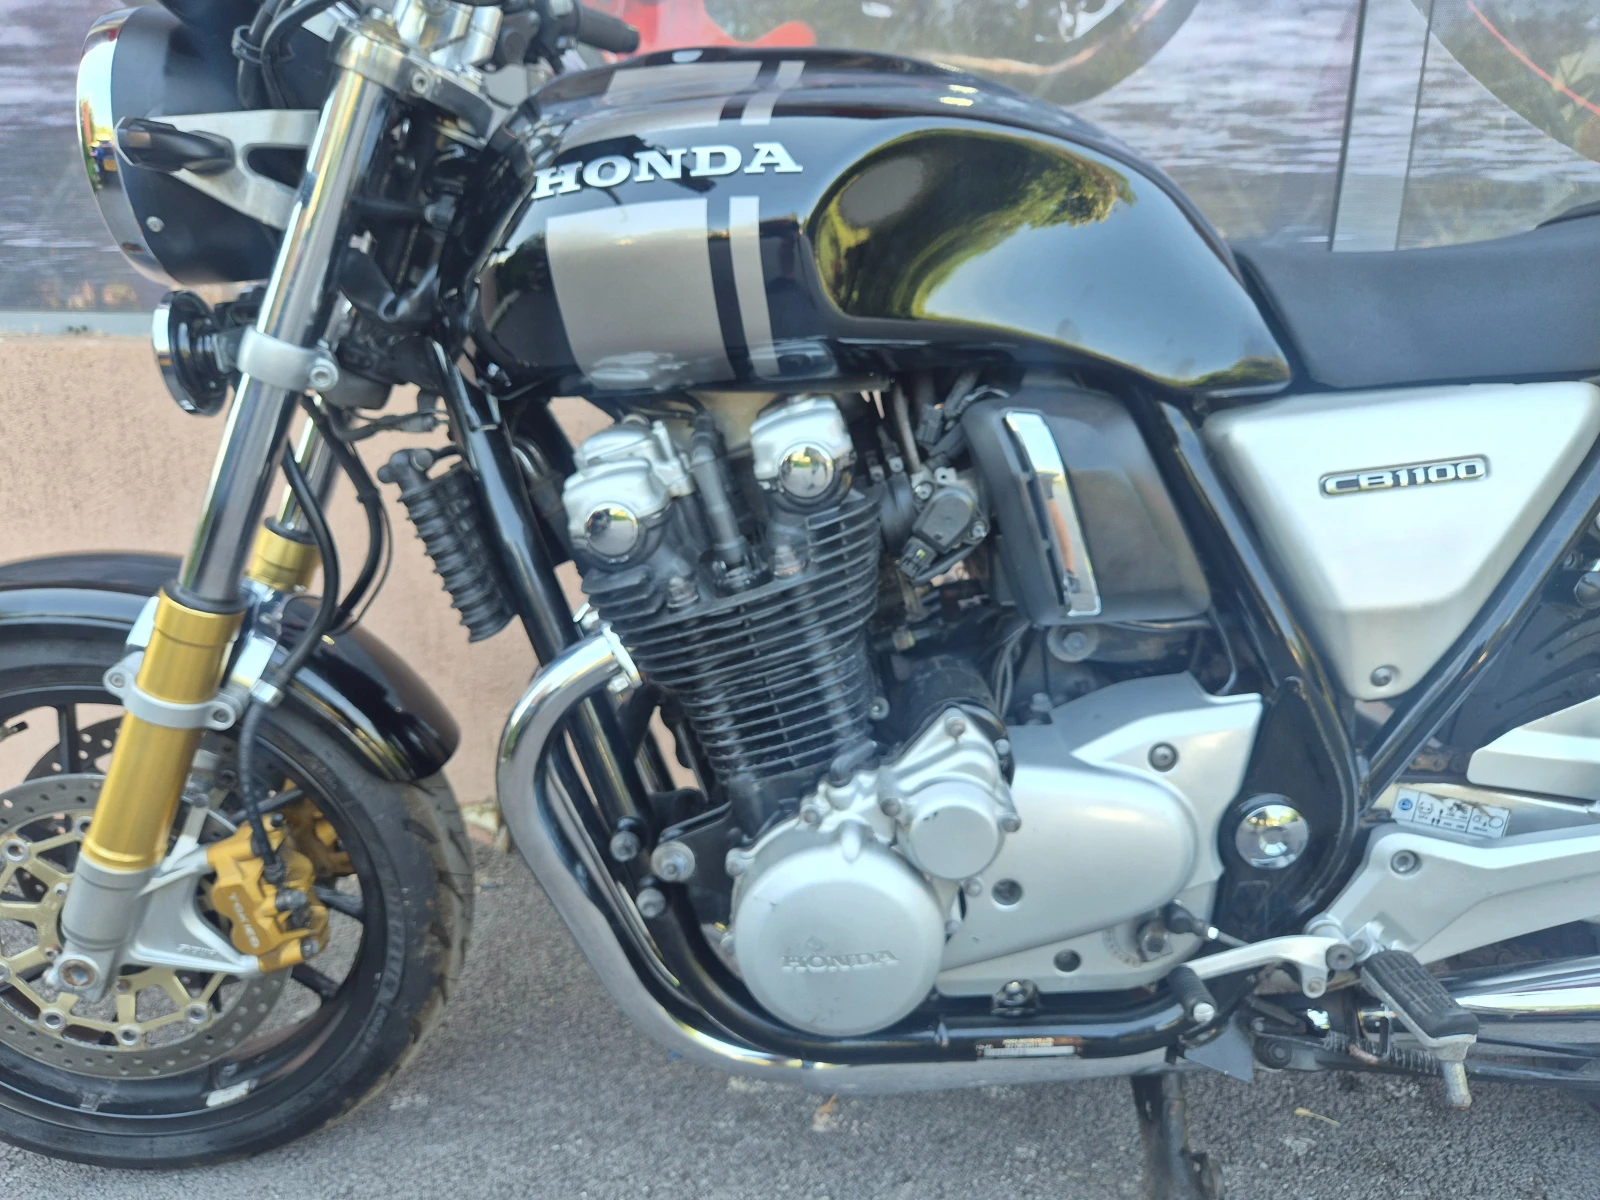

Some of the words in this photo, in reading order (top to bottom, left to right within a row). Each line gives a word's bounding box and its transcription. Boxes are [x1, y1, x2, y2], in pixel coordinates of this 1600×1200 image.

[532, 142, 803, 199] HONDA
[1324, 461, 1486, 494] CB1100
[780, 949, 900, 973] HONDA
